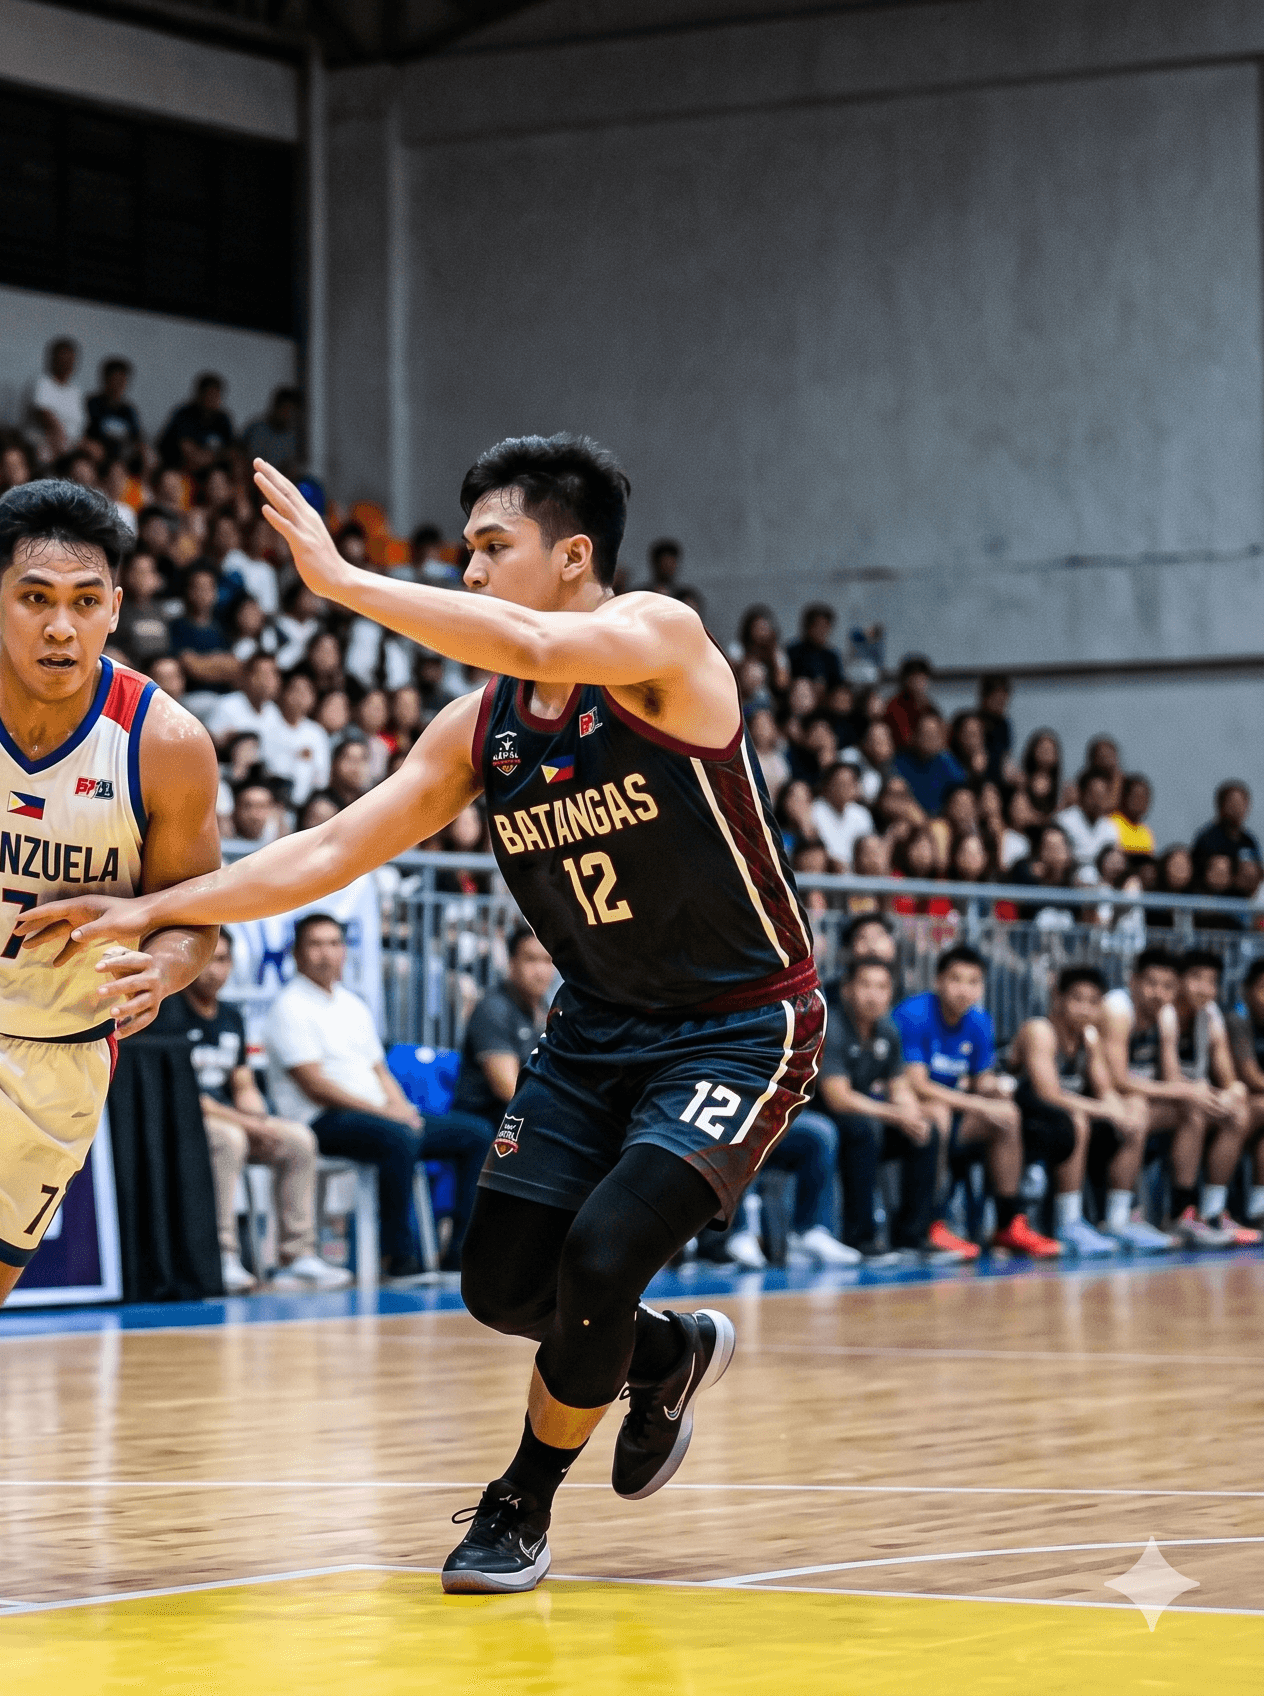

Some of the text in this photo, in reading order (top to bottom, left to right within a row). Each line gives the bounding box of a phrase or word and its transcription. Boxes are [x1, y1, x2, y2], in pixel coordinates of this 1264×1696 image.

[493, 773, 659, 855] BATANGAS
[0, 887, 38, 960] 7
[562, 851, 634, 925] 12
[679, 1080, 742, 1140] 12
[23, 1184, 59, 1235] 7
